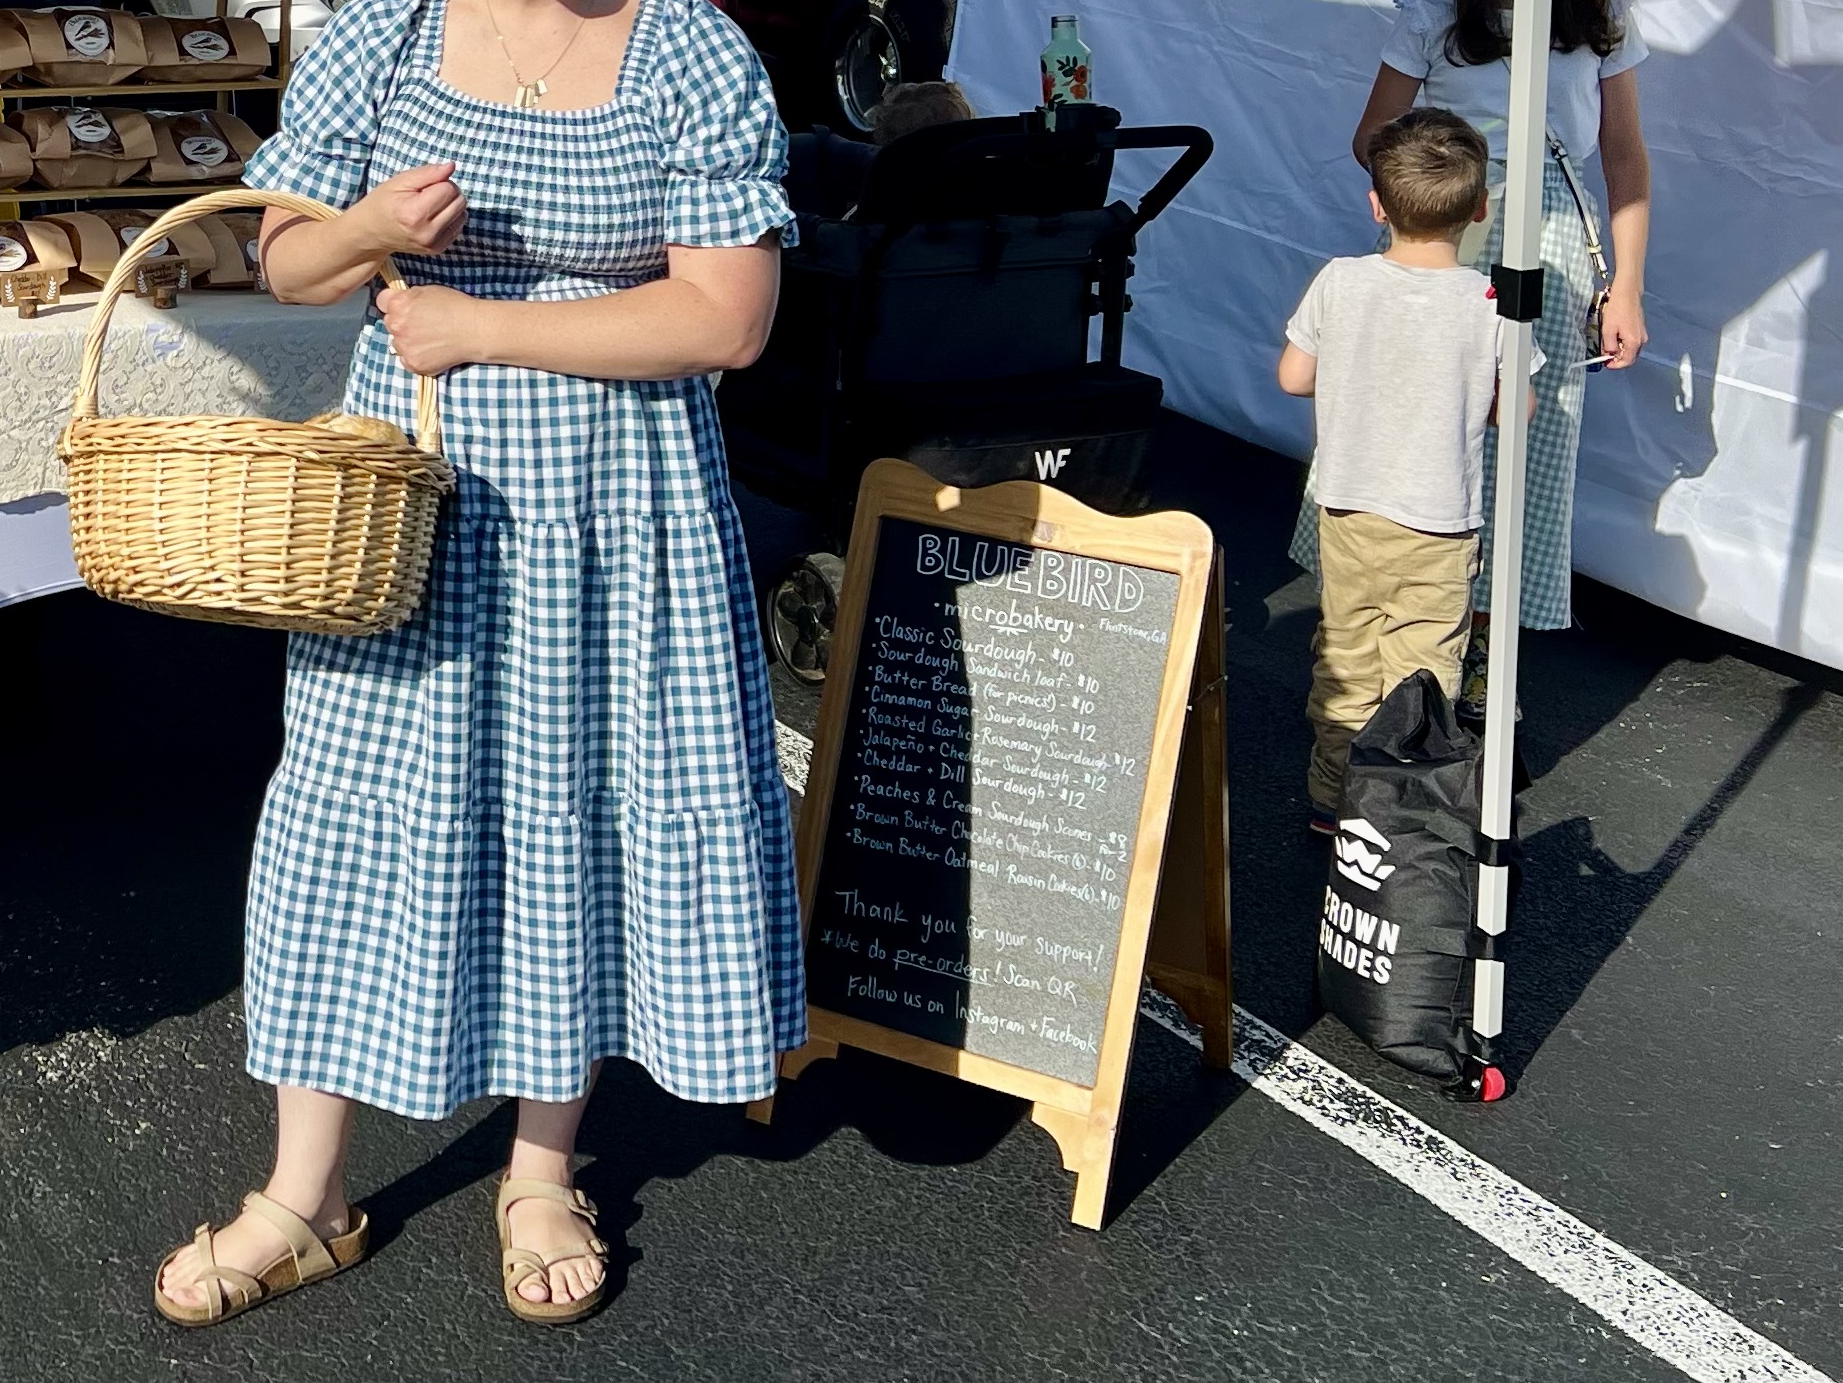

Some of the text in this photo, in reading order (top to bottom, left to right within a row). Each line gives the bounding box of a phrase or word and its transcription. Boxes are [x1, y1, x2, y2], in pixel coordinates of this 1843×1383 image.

[917, 534, 1144, 613] BLUEBIRD
[879, 615, 935, 644] Classic
[1052, 648, 1074, 667] $10
[944, 598, 1075, 644] microbakery
[874, 665, 927, 689] Butter
[931, 675, 978, 697] Bread
[1072, 696, 1095, 715] $10
[878, 641, 959, 676] Sourdough
[967, 657, 1031, 684] Sandwich
[1077, 674, 1100, 694] $10
[868, 706, 927, 733] Roasted
[932, 719, 972, 741] Garlic
[981, 726, 1042, 763] Rosemary
[1115, 752, 1136, 776] $12
[871, 685, 932, 710] Cinnamon
[937, 697, 980, 720] Sugar
[1072, 721, 1096, 743] $12
[863, 727, 925, 753] Jalapeño
[939, 741, 999, 768] Cheddar
[1003, 755, 1070, 788] Sourdough
[1084, 773, 1106, 793] $12
[864, 749, 922, 773] Cheddar
[940, 762, 966, 783] Dill
[972, 768, 1045, 805] Sourdough
[1060, 788, 1087, 810] $12
[860, 774, 920, 803] Peaches
[926, 788, 936, 806] &
[942, 790, 983, 817] Cream
[988, 801, 1050, 836] Sourdough
[853, 828, 894, 854] Brown
[899, 837, 941, 860] Butter
[944, 846, 999, 878] Oatmeal
[1006, 864, 1046, 890] Raisin
[856, 803, 898, 826] Brown
[904, 810, 947, 834] Butter
[951, 820, 1004, 849] Chocolate
[1094, 859, 1116, 882] $10
[835, 889, 908, 924] Thank
[921, 914, 957, 943] you
[966, 915, 988, 939] for
[995, 928, 1027, 952] your
[1319, 917, 1392, 985] SHADES
[1324, 885, 1400, 955] CROWN
[868, 938, 886, 960] do
[893, 949, 1002, 985] pre-orders!
[1003, 963, 1042, 991] Scan
[1046, 974, 1078, 1007] QR
[847, 975, 897, 1002] Follow
[903, 991, 922, 1008] us
[927, 1000, 944, 1014] on
[955, 990, 1025, 1035] Instagram
[1039, 1015, 1098, 1054] Facebook
